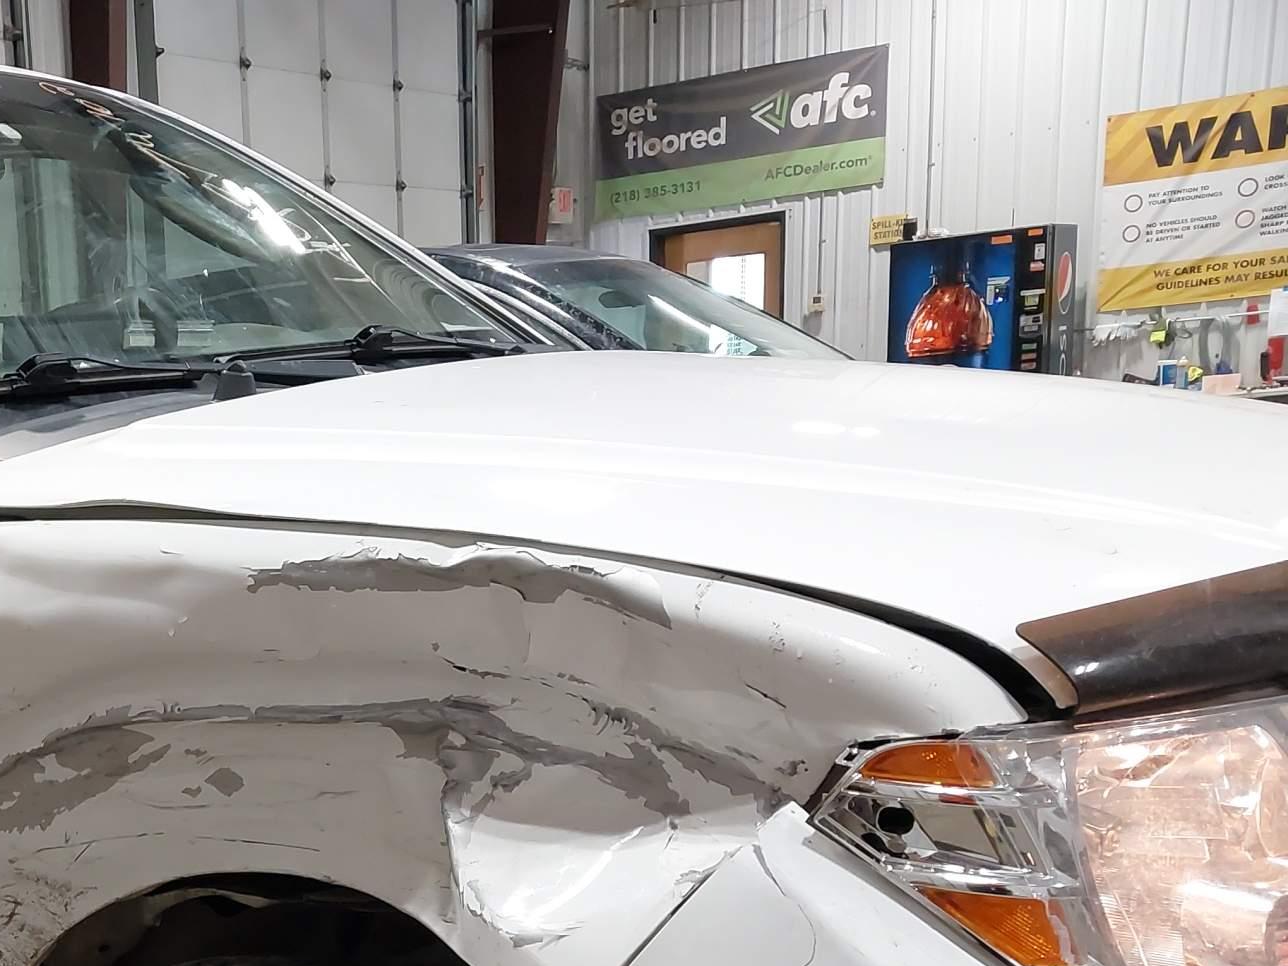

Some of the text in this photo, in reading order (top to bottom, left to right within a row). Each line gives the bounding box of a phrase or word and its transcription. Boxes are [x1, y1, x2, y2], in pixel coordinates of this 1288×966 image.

[611, 98, 657, 135] get
[625, 116, 727, 159] floored
[765, 157, 868, 180] AFCDealer.com
[610, 180, 701, 208] (218) 385-3131
[1162, 187, 1199, 196] ATTENTION
[1168, 191, 1223, 203] SURROUNDINGS
[1159, 218, 1189, 226] VEHICLES
[1190, 214, 1218, 222] SHOULD
[1193, 221, 1221, 230] STARTED
[1154, 255, 1288, 278] WE CARE FOR YOUR SA
[1156, 276, 1221, 291] GUIDELINES
[1224, 273, 1250, 284] MAY
